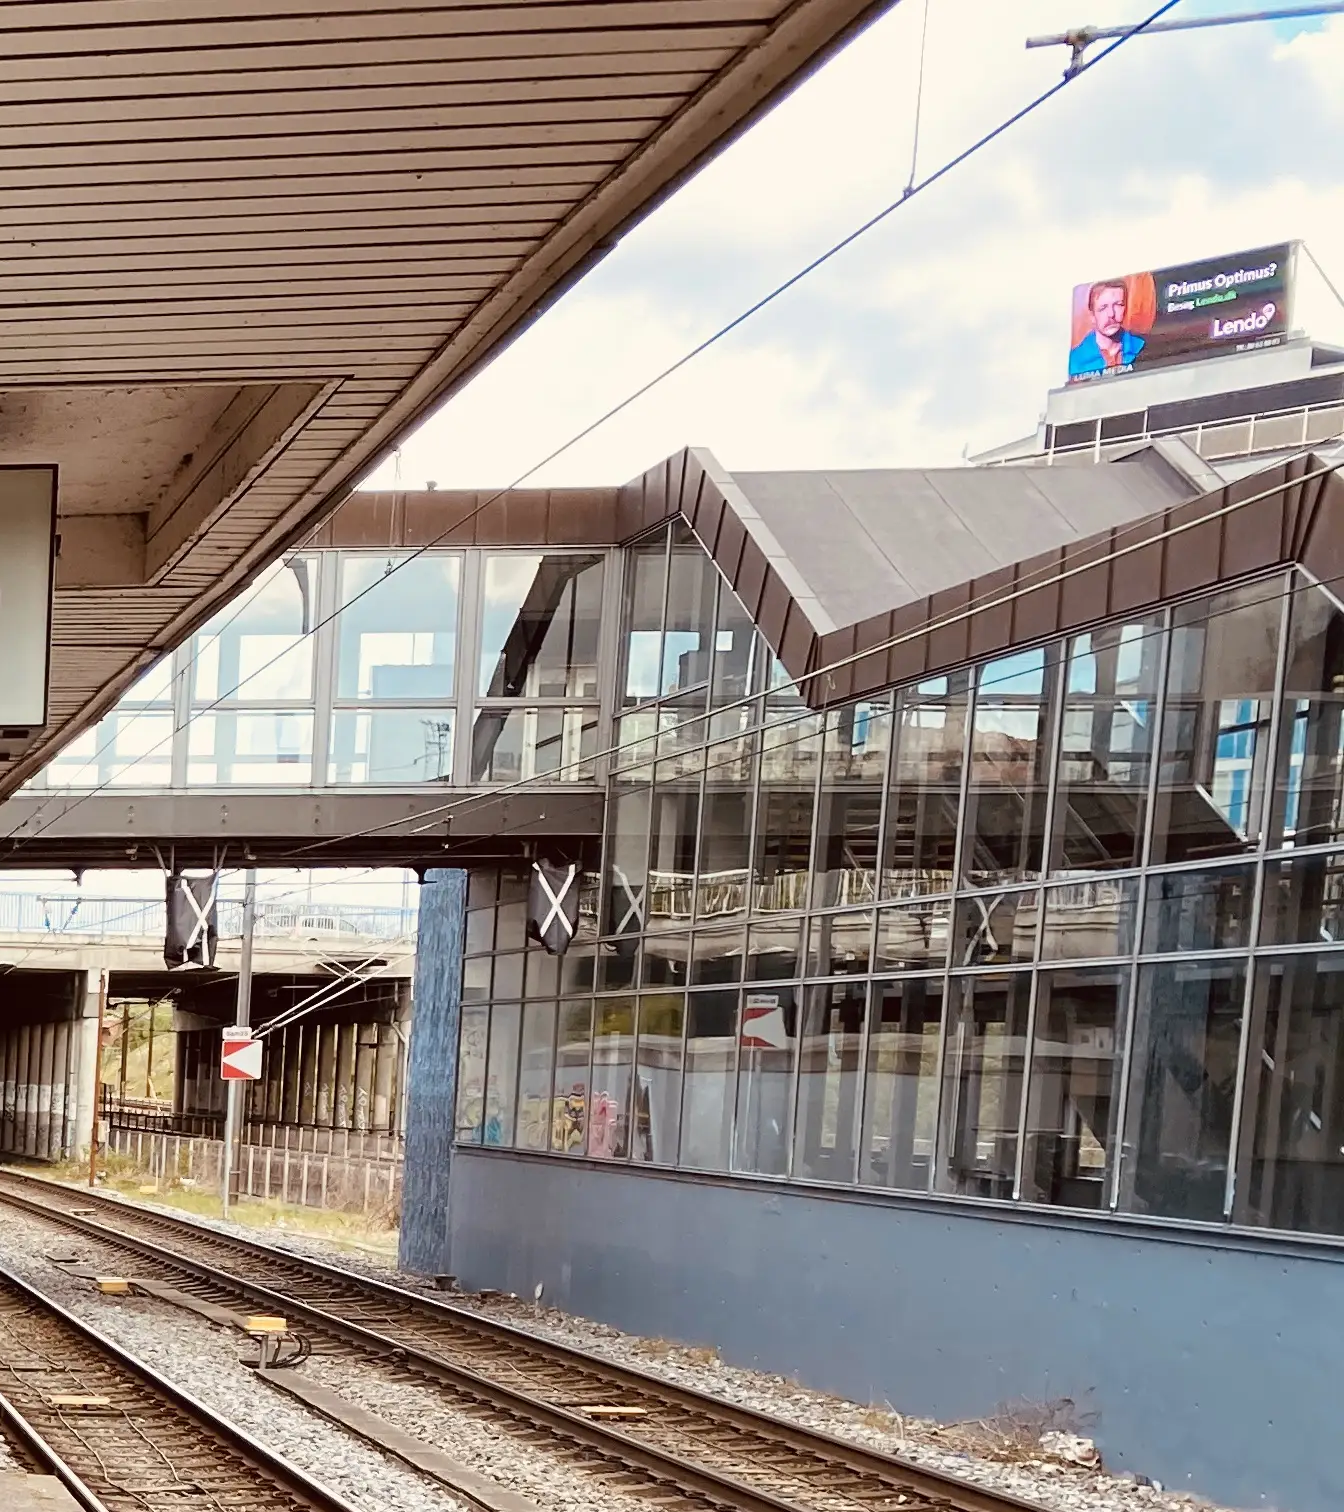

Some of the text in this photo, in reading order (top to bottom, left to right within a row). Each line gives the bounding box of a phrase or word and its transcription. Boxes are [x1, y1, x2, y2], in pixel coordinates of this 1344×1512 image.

[1168, 262, 1278, 298] Primus Optimus?
[1213, 311, 1270, 338] Lendo
